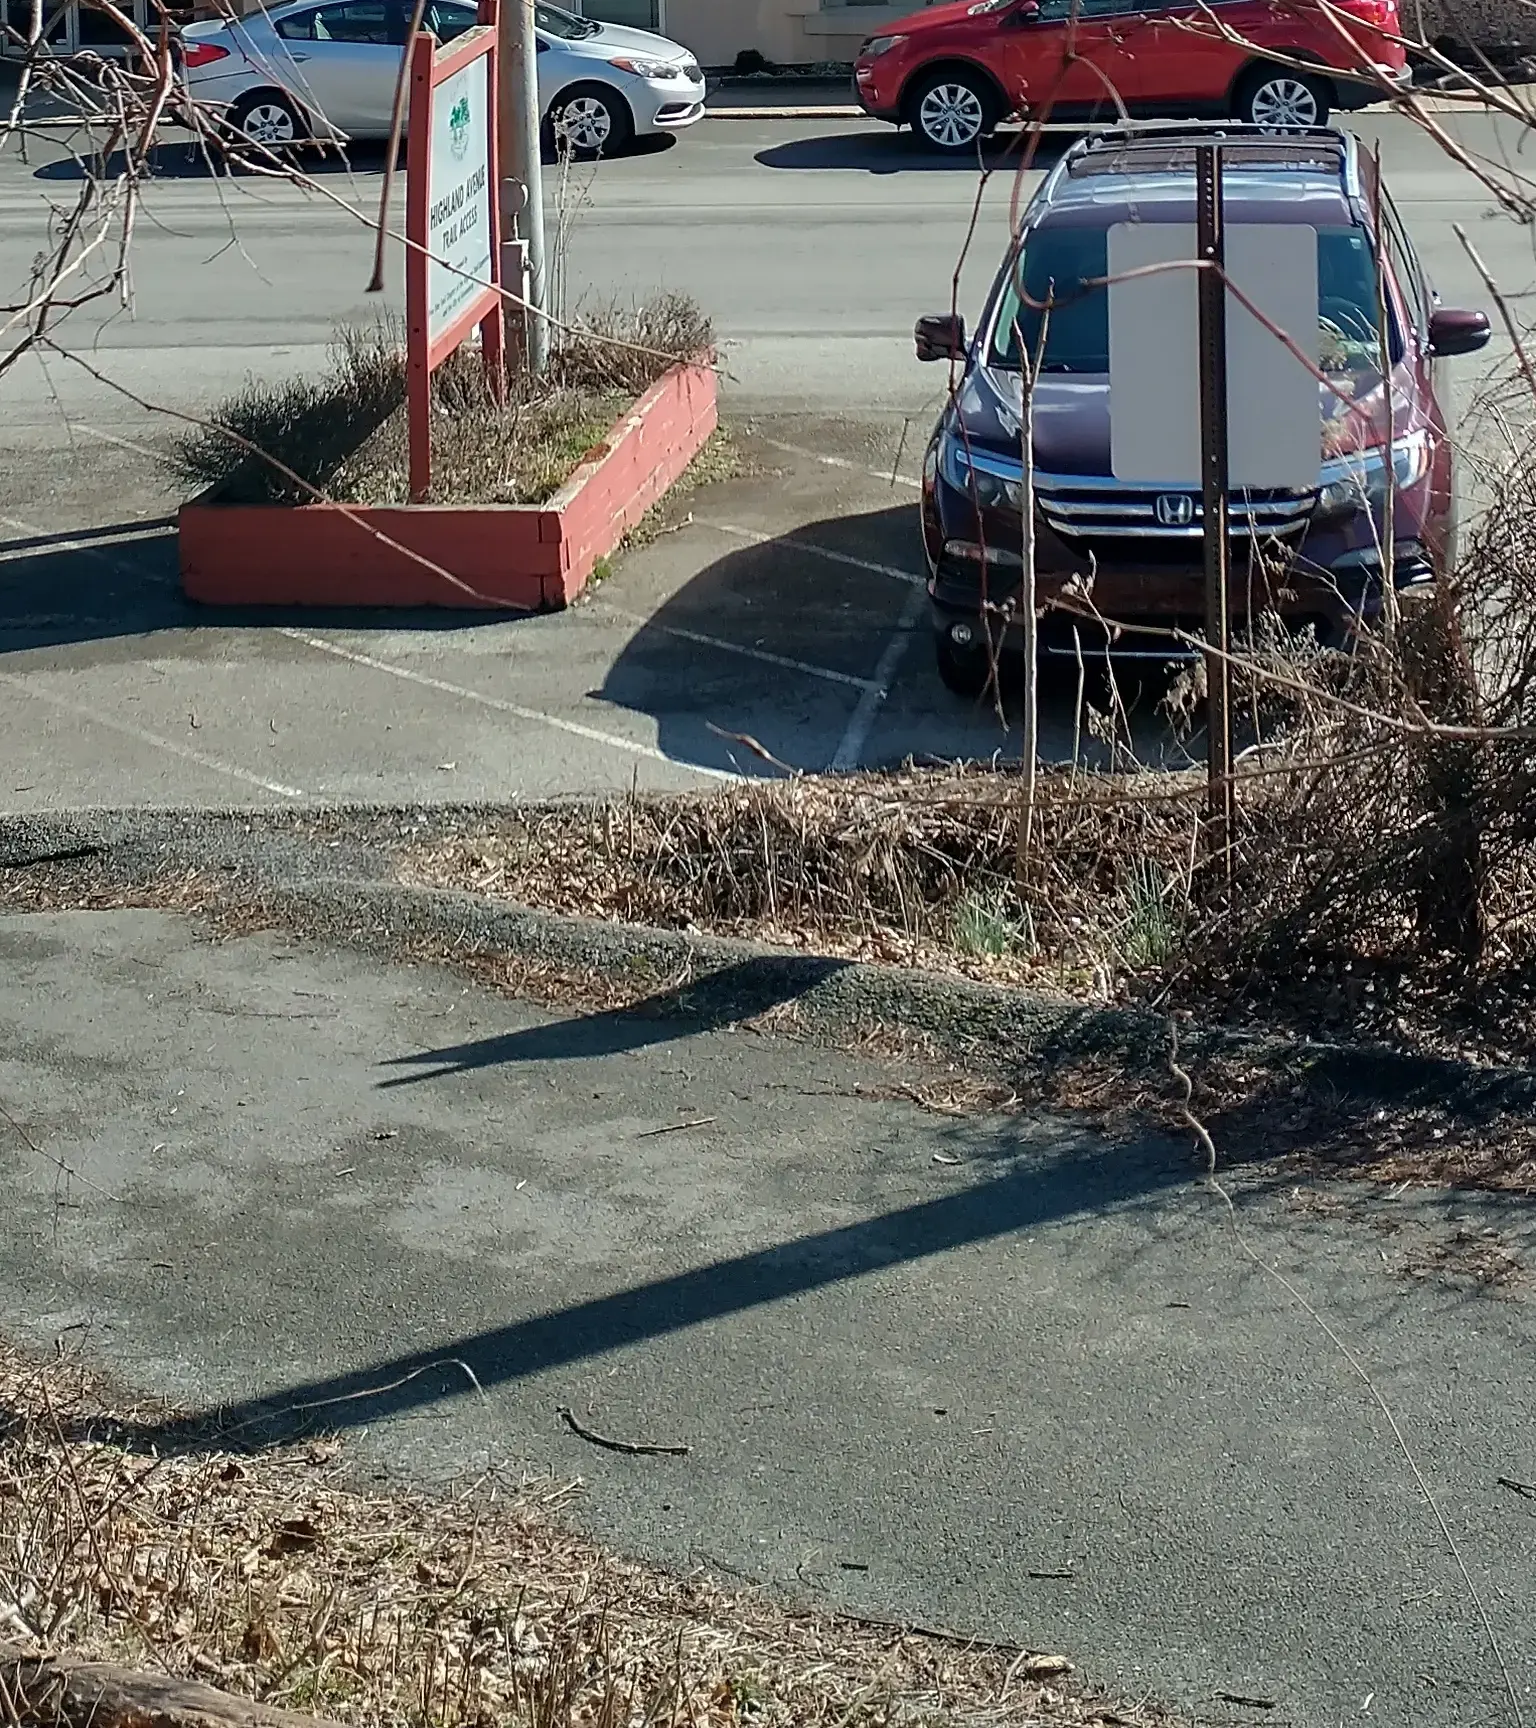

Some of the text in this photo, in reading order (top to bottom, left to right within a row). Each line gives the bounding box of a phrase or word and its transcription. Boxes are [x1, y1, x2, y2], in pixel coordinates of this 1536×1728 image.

[430, 163, 485, 231] HIGHLAND AVENUE
[442, 204, 478, 253] TRAIL ACCESS
